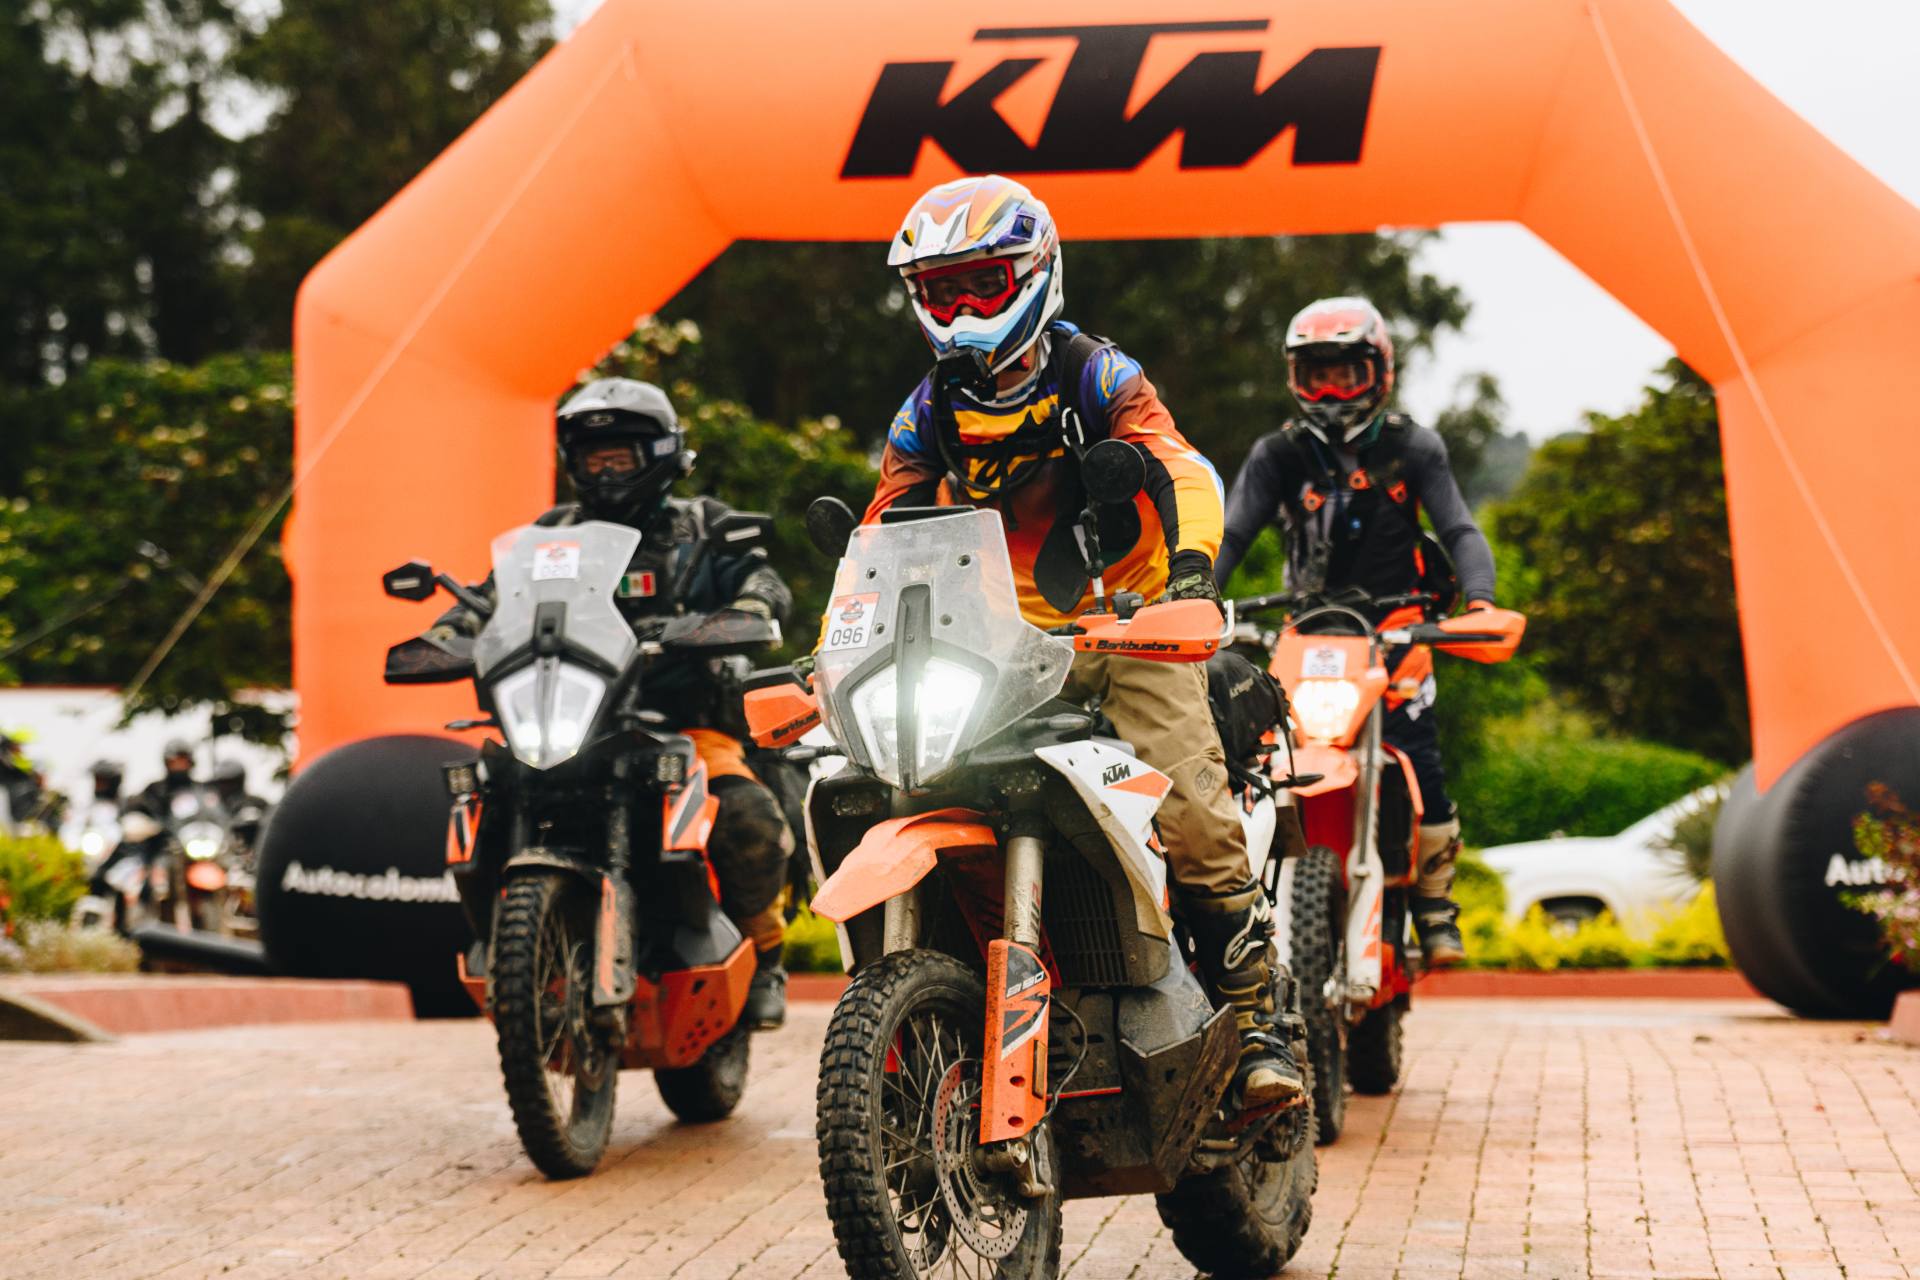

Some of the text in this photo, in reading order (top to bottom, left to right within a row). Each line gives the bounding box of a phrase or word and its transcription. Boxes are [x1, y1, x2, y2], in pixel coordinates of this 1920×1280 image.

[839, 20, 1382, 179] KTM
[831, 626, 864, 646] 096
[1096, 640, 1180, 651] Barkbusters
[1102, 762, 1131, 786] KTM
